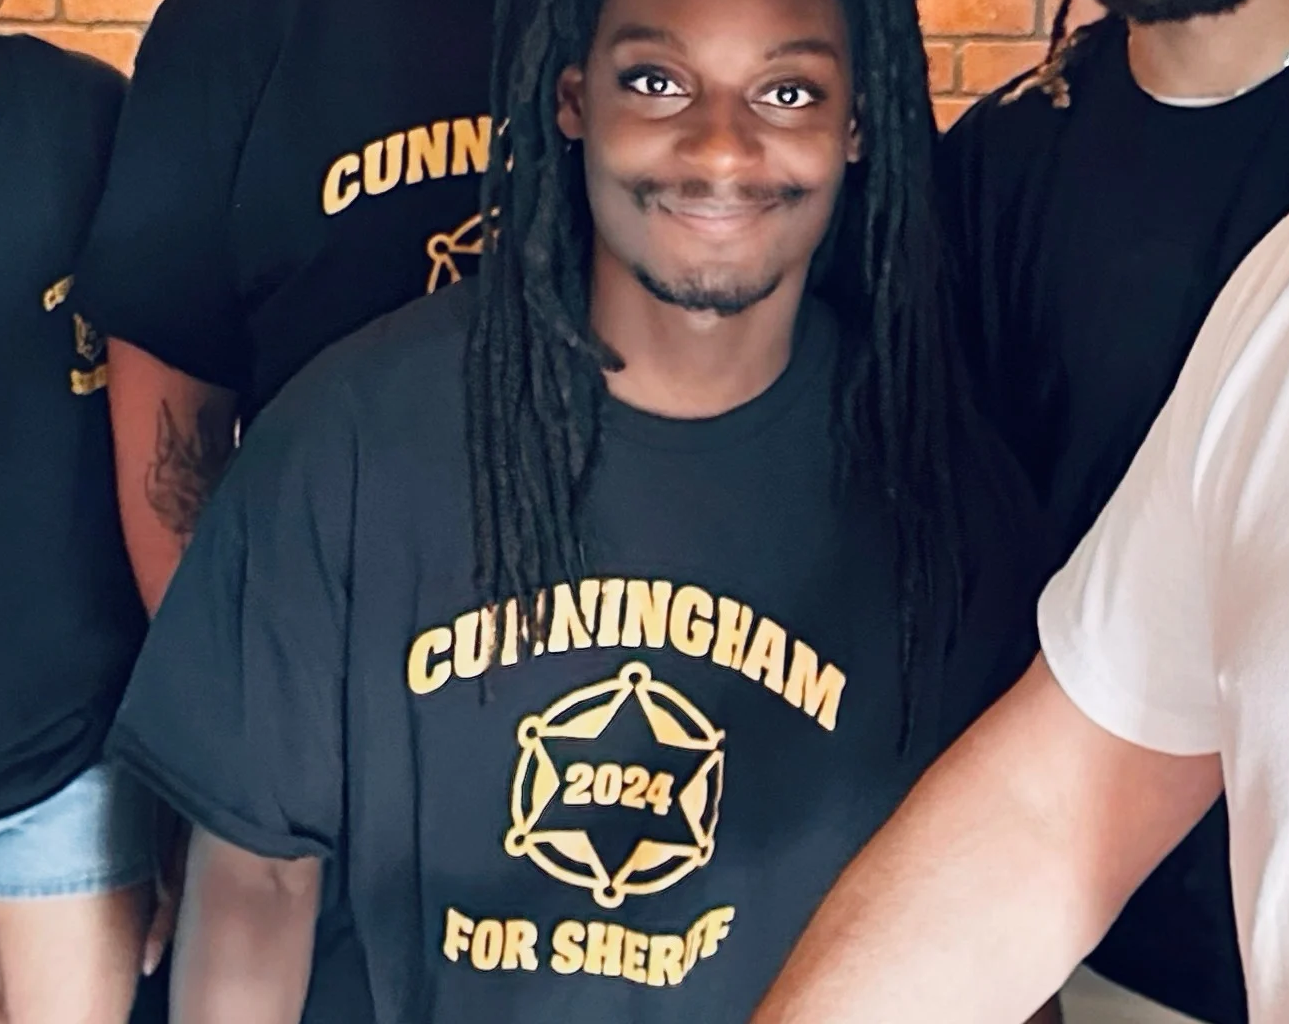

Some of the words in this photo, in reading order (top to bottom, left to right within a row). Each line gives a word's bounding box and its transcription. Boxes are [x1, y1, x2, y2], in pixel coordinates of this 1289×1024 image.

[322, 114, 514, 216] CUNN
[563, 763, 674, 815] 2024
[444, 907, 539, 971] FOR
